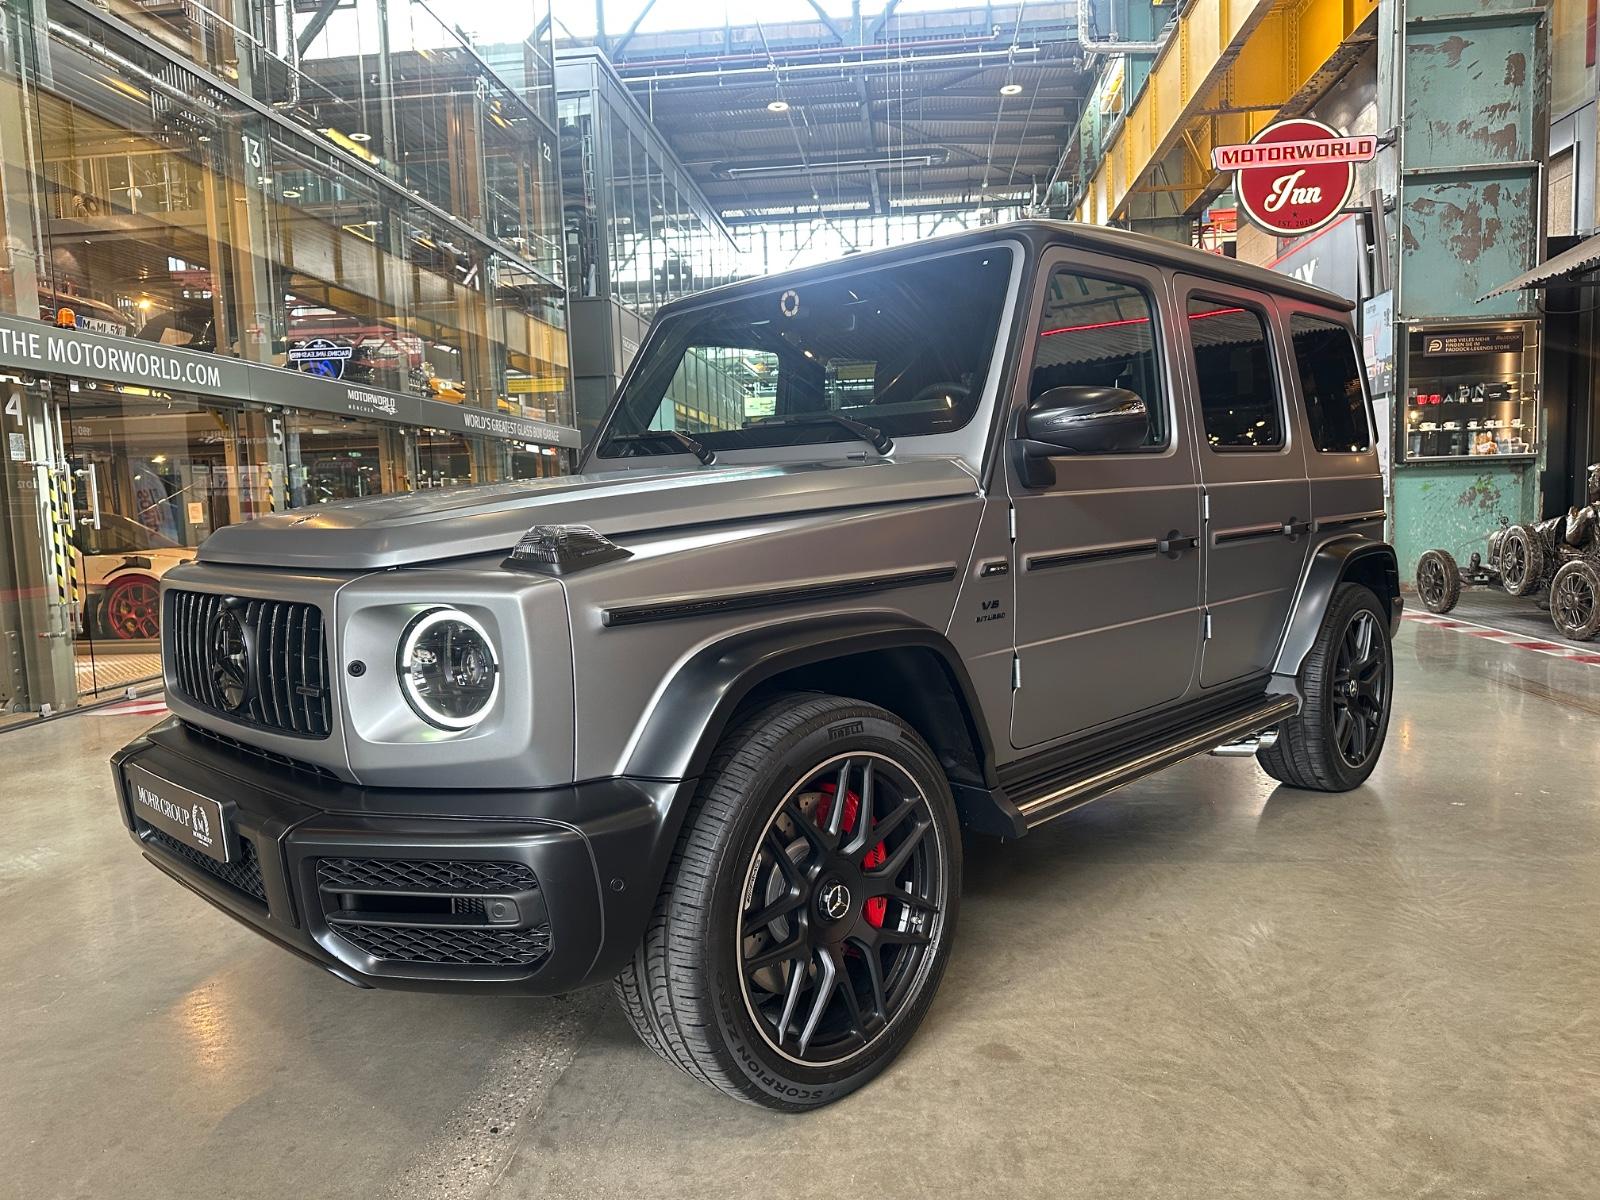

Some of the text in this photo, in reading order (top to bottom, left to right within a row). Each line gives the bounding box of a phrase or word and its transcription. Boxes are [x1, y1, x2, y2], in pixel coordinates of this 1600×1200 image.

[242, 135, 261, 168] 13
[1222, 140, 1372, 165] MOTORWORLD
[1263, 169, 1322, 212] Inn
[0, 328, 221, 388] THE MOTORWORLD.COM
[5, 390, 24, 426] 4
[347, 389, 395, 407] MOTORWORLD
[273, 418, 284, 446] 5
[463, 412, 491, 430] WORLD'S
[491, 418, 517, 434] GREATEST
[137, 785, 190, 827] MOHR GROUP
[736, 1045, 824, 1101] SCORPION
